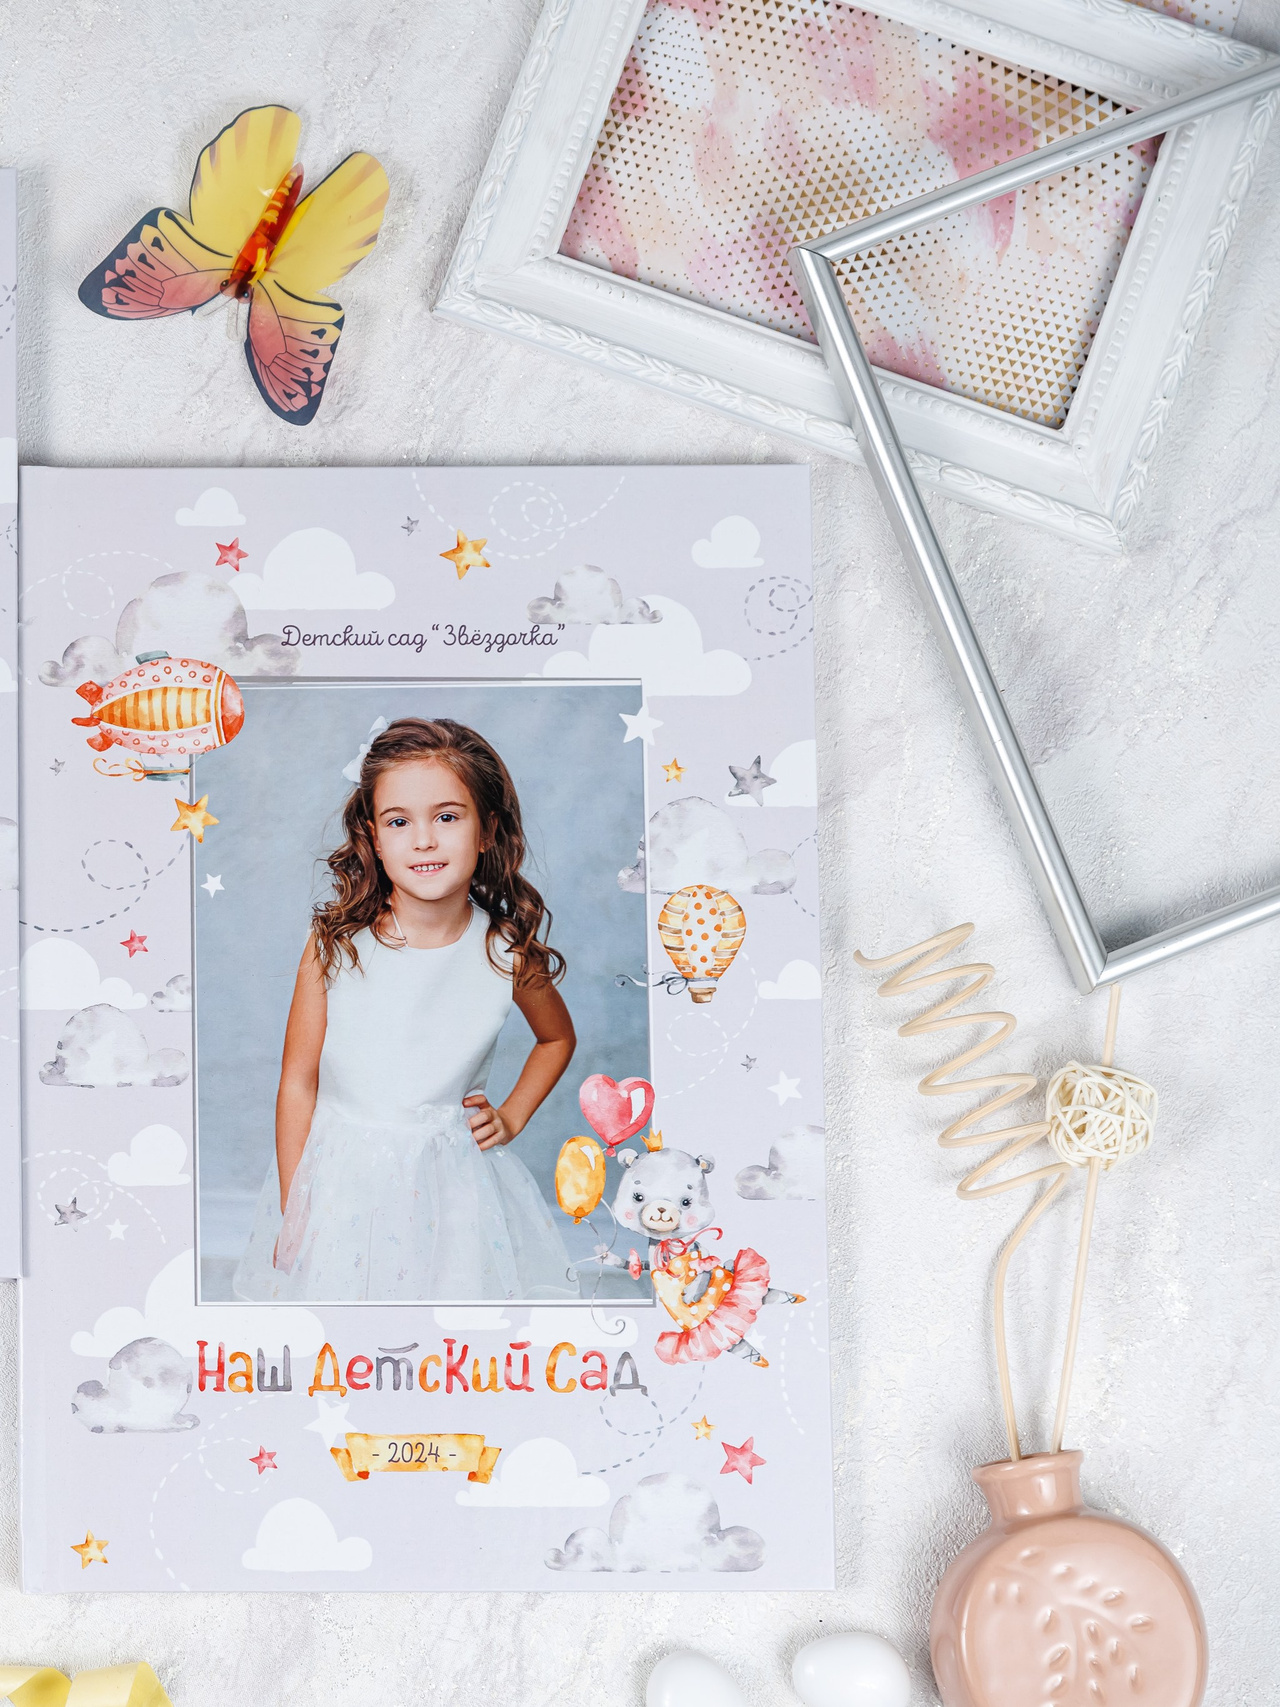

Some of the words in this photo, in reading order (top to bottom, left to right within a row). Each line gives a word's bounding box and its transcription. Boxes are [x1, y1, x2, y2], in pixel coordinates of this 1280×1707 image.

[280, 624, 385, 647] Детский
[387, 633, 428, 654] сад
[196, 1340, 293, 1394] Наш
[307, 1337, 535, 1398] Детский
[544, 1341, 648, 1397] Сад
